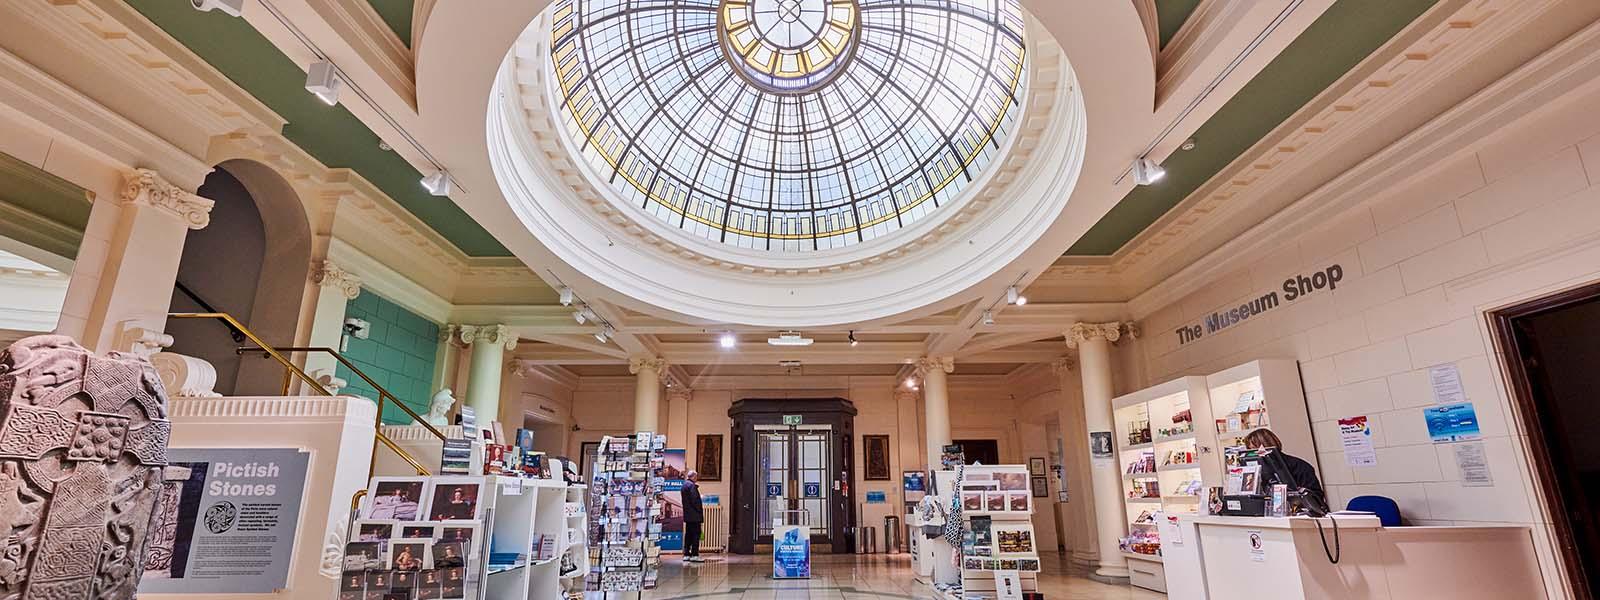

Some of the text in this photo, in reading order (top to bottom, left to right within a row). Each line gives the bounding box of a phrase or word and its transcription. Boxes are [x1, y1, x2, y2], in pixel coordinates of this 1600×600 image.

[1175, 263, 1343, 345] The Museum Shop
[213, 462, 280, 478] Pictish
[209, 480, 277, 496] Stones
